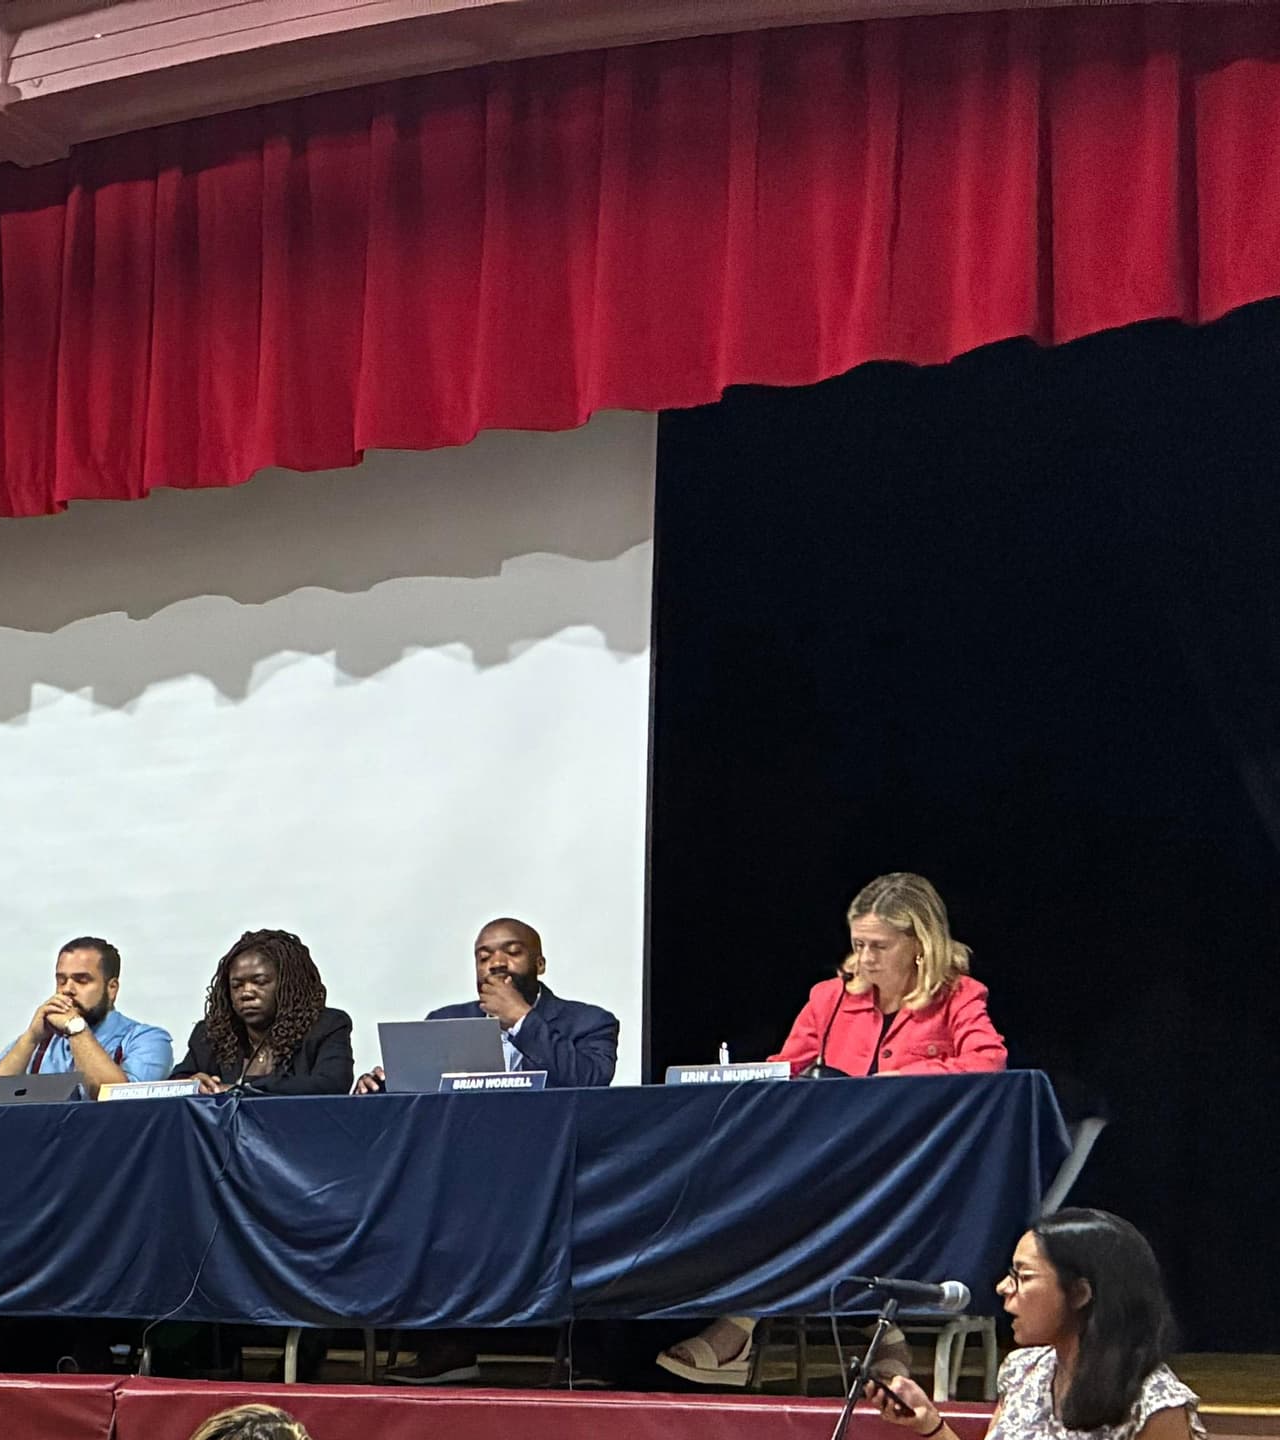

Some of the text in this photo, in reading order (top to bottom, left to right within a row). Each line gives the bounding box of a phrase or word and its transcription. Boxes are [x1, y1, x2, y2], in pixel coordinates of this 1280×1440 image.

[452, 1076, 533, 1089] BRIAN WORRELL
[680, 1068, 773, 1083] ERIN J. MURPHY
